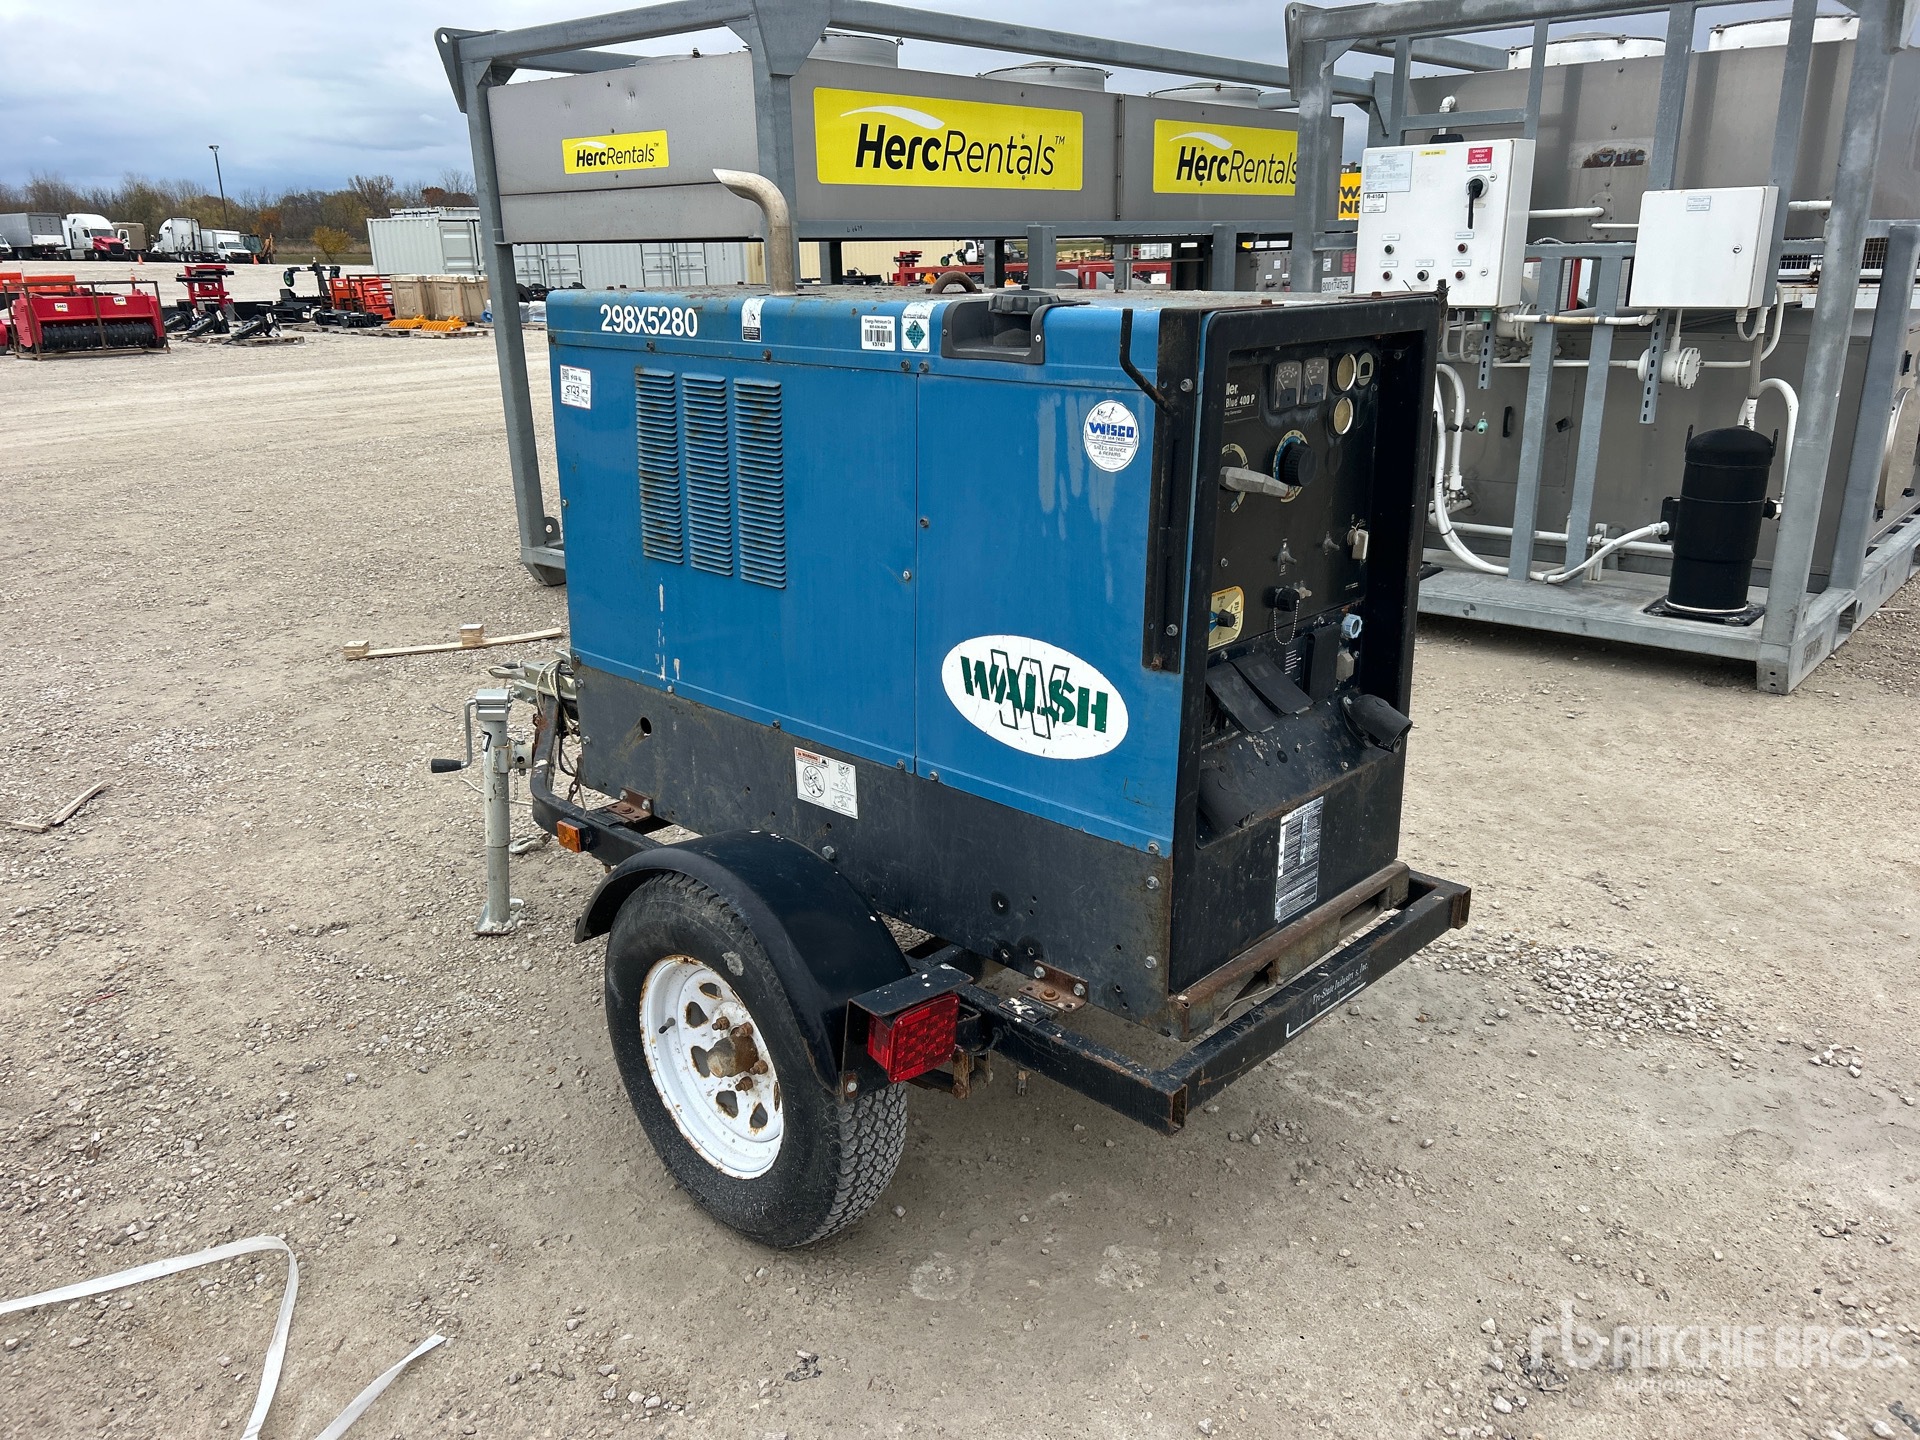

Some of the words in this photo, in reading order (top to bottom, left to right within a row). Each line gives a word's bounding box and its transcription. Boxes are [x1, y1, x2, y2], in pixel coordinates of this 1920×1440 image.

[600, 304, 698, 328] 298X5280
[1089, 422, 1134, 438] WISCO
[960, 655, 1109, 734] WALSH
